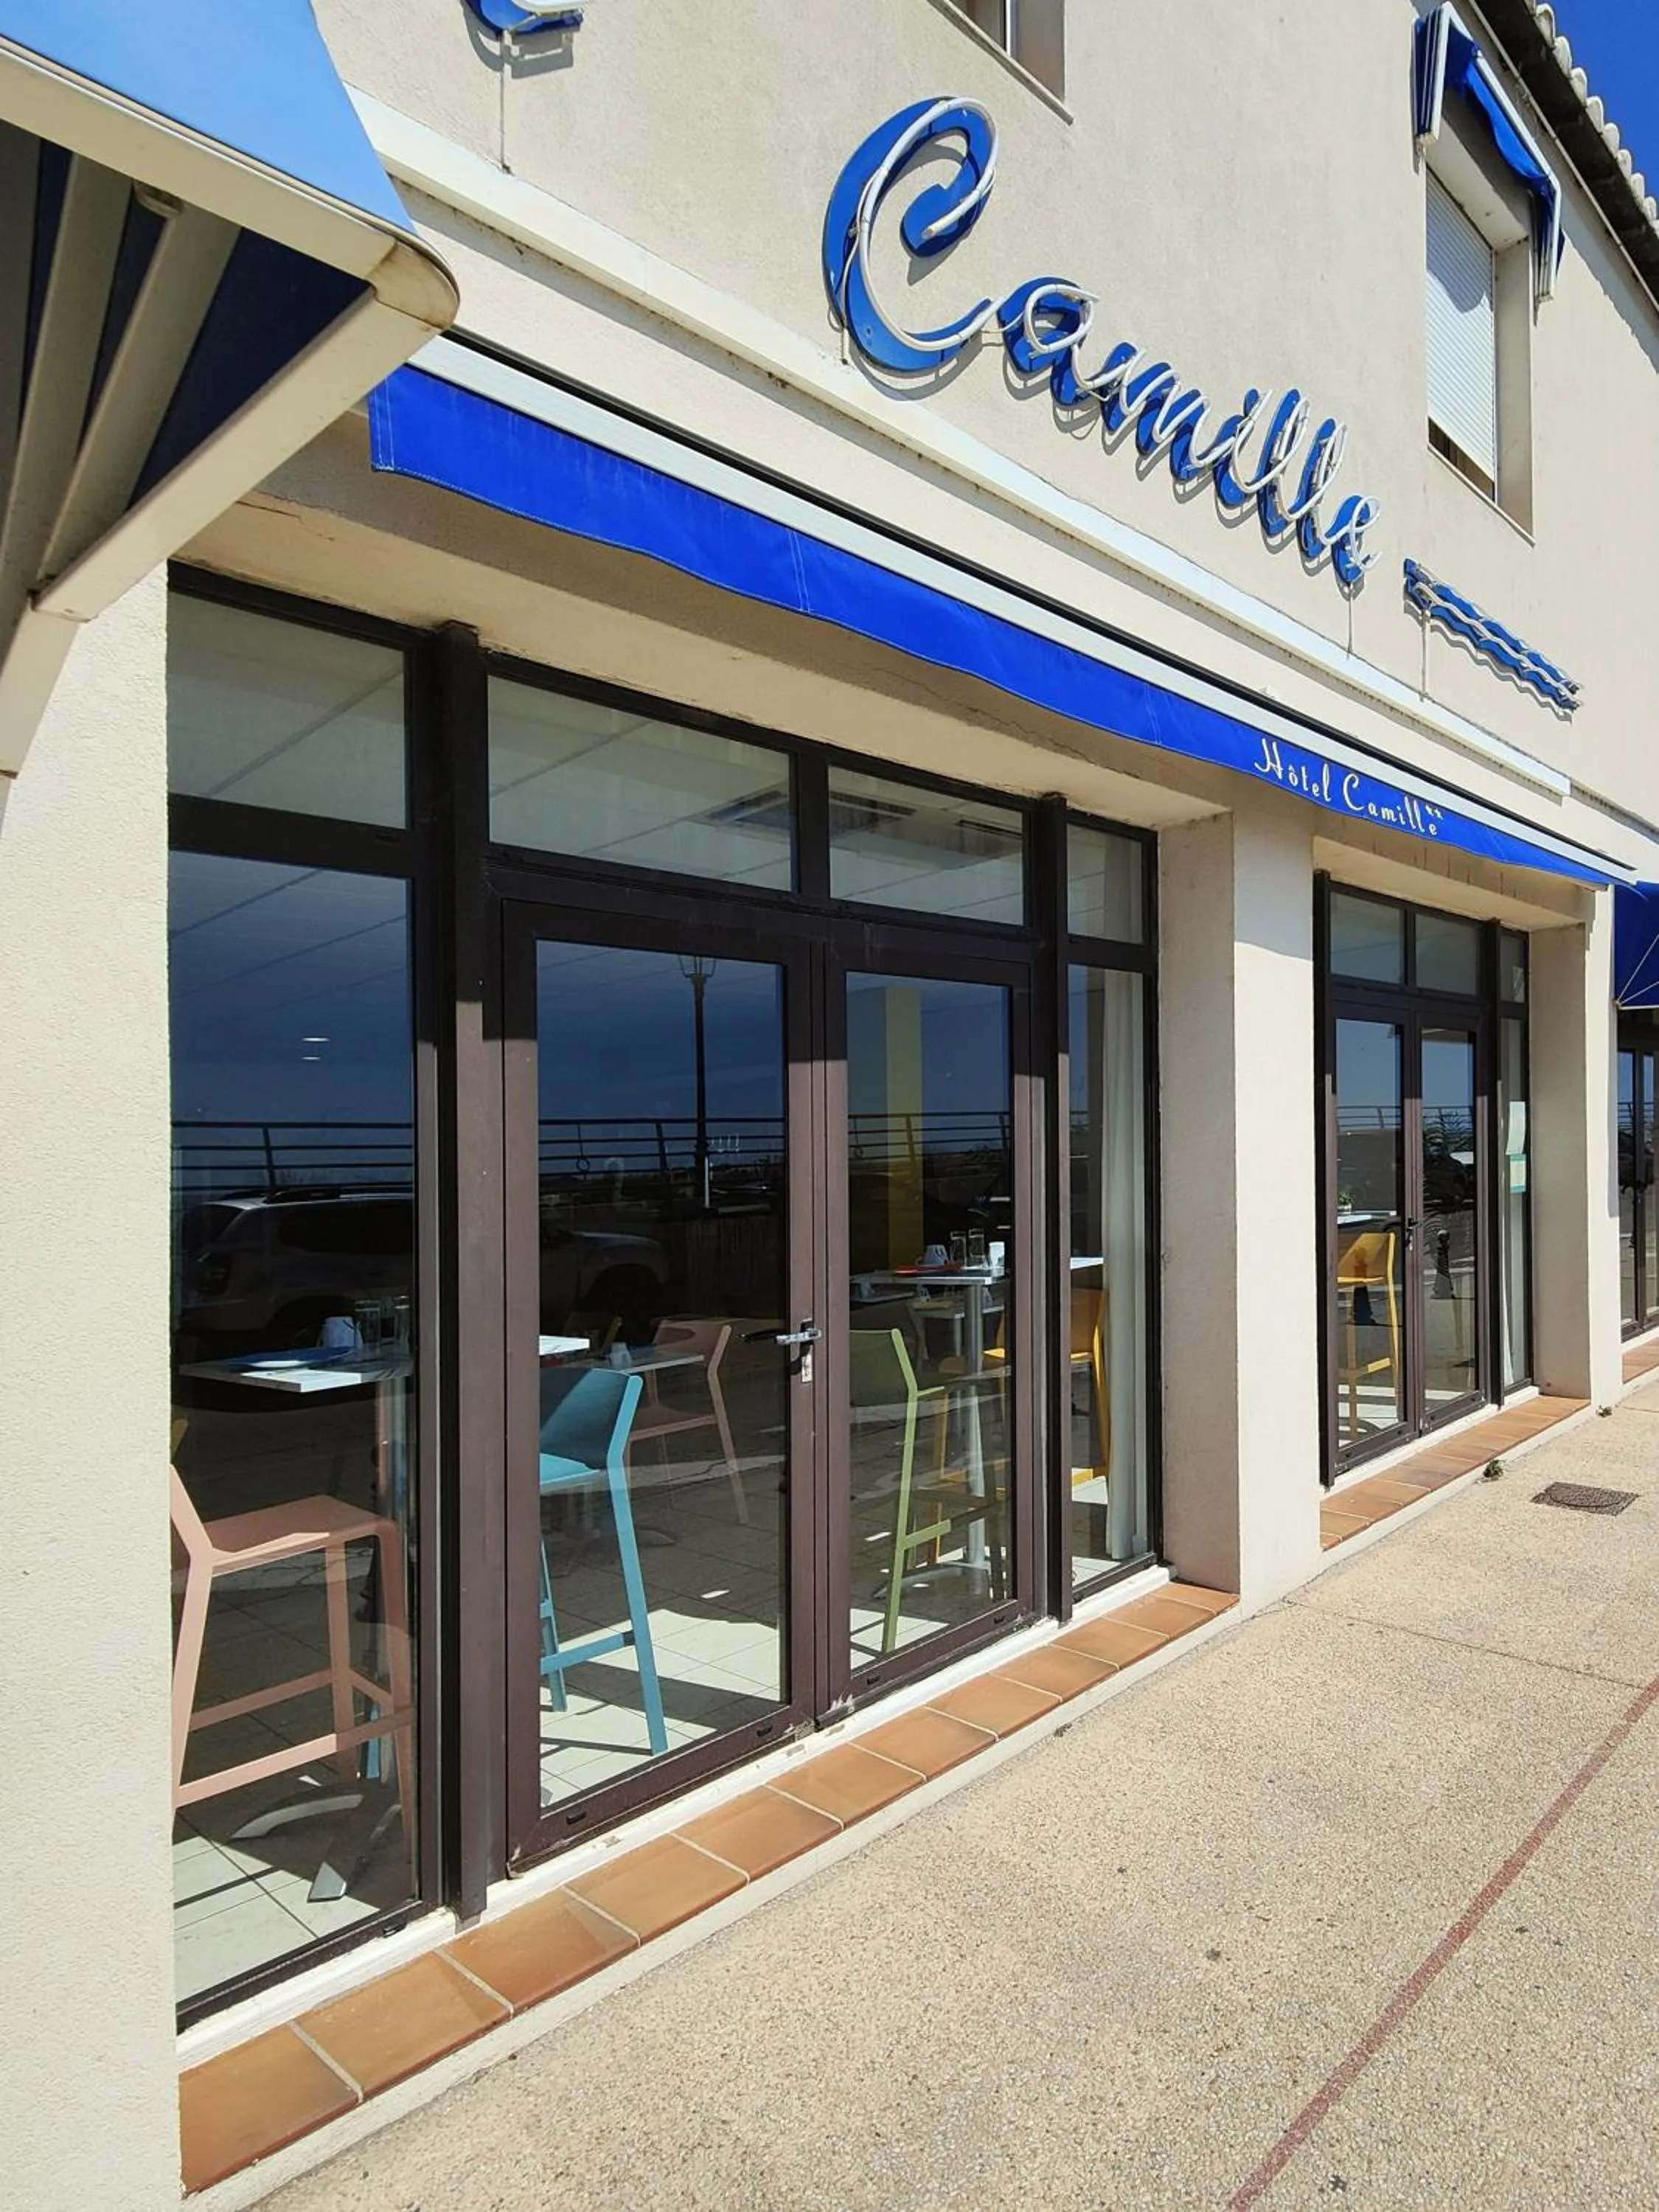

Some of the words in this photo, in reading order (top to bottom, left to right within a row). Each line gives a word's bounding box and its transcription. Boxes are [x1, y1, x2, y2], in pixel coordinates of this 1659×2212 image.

[822, 96, 1382, 585] Camille
[1254, 738, 1331, 801] Hôtel
[1343, 773, 1438, 835] Camille
